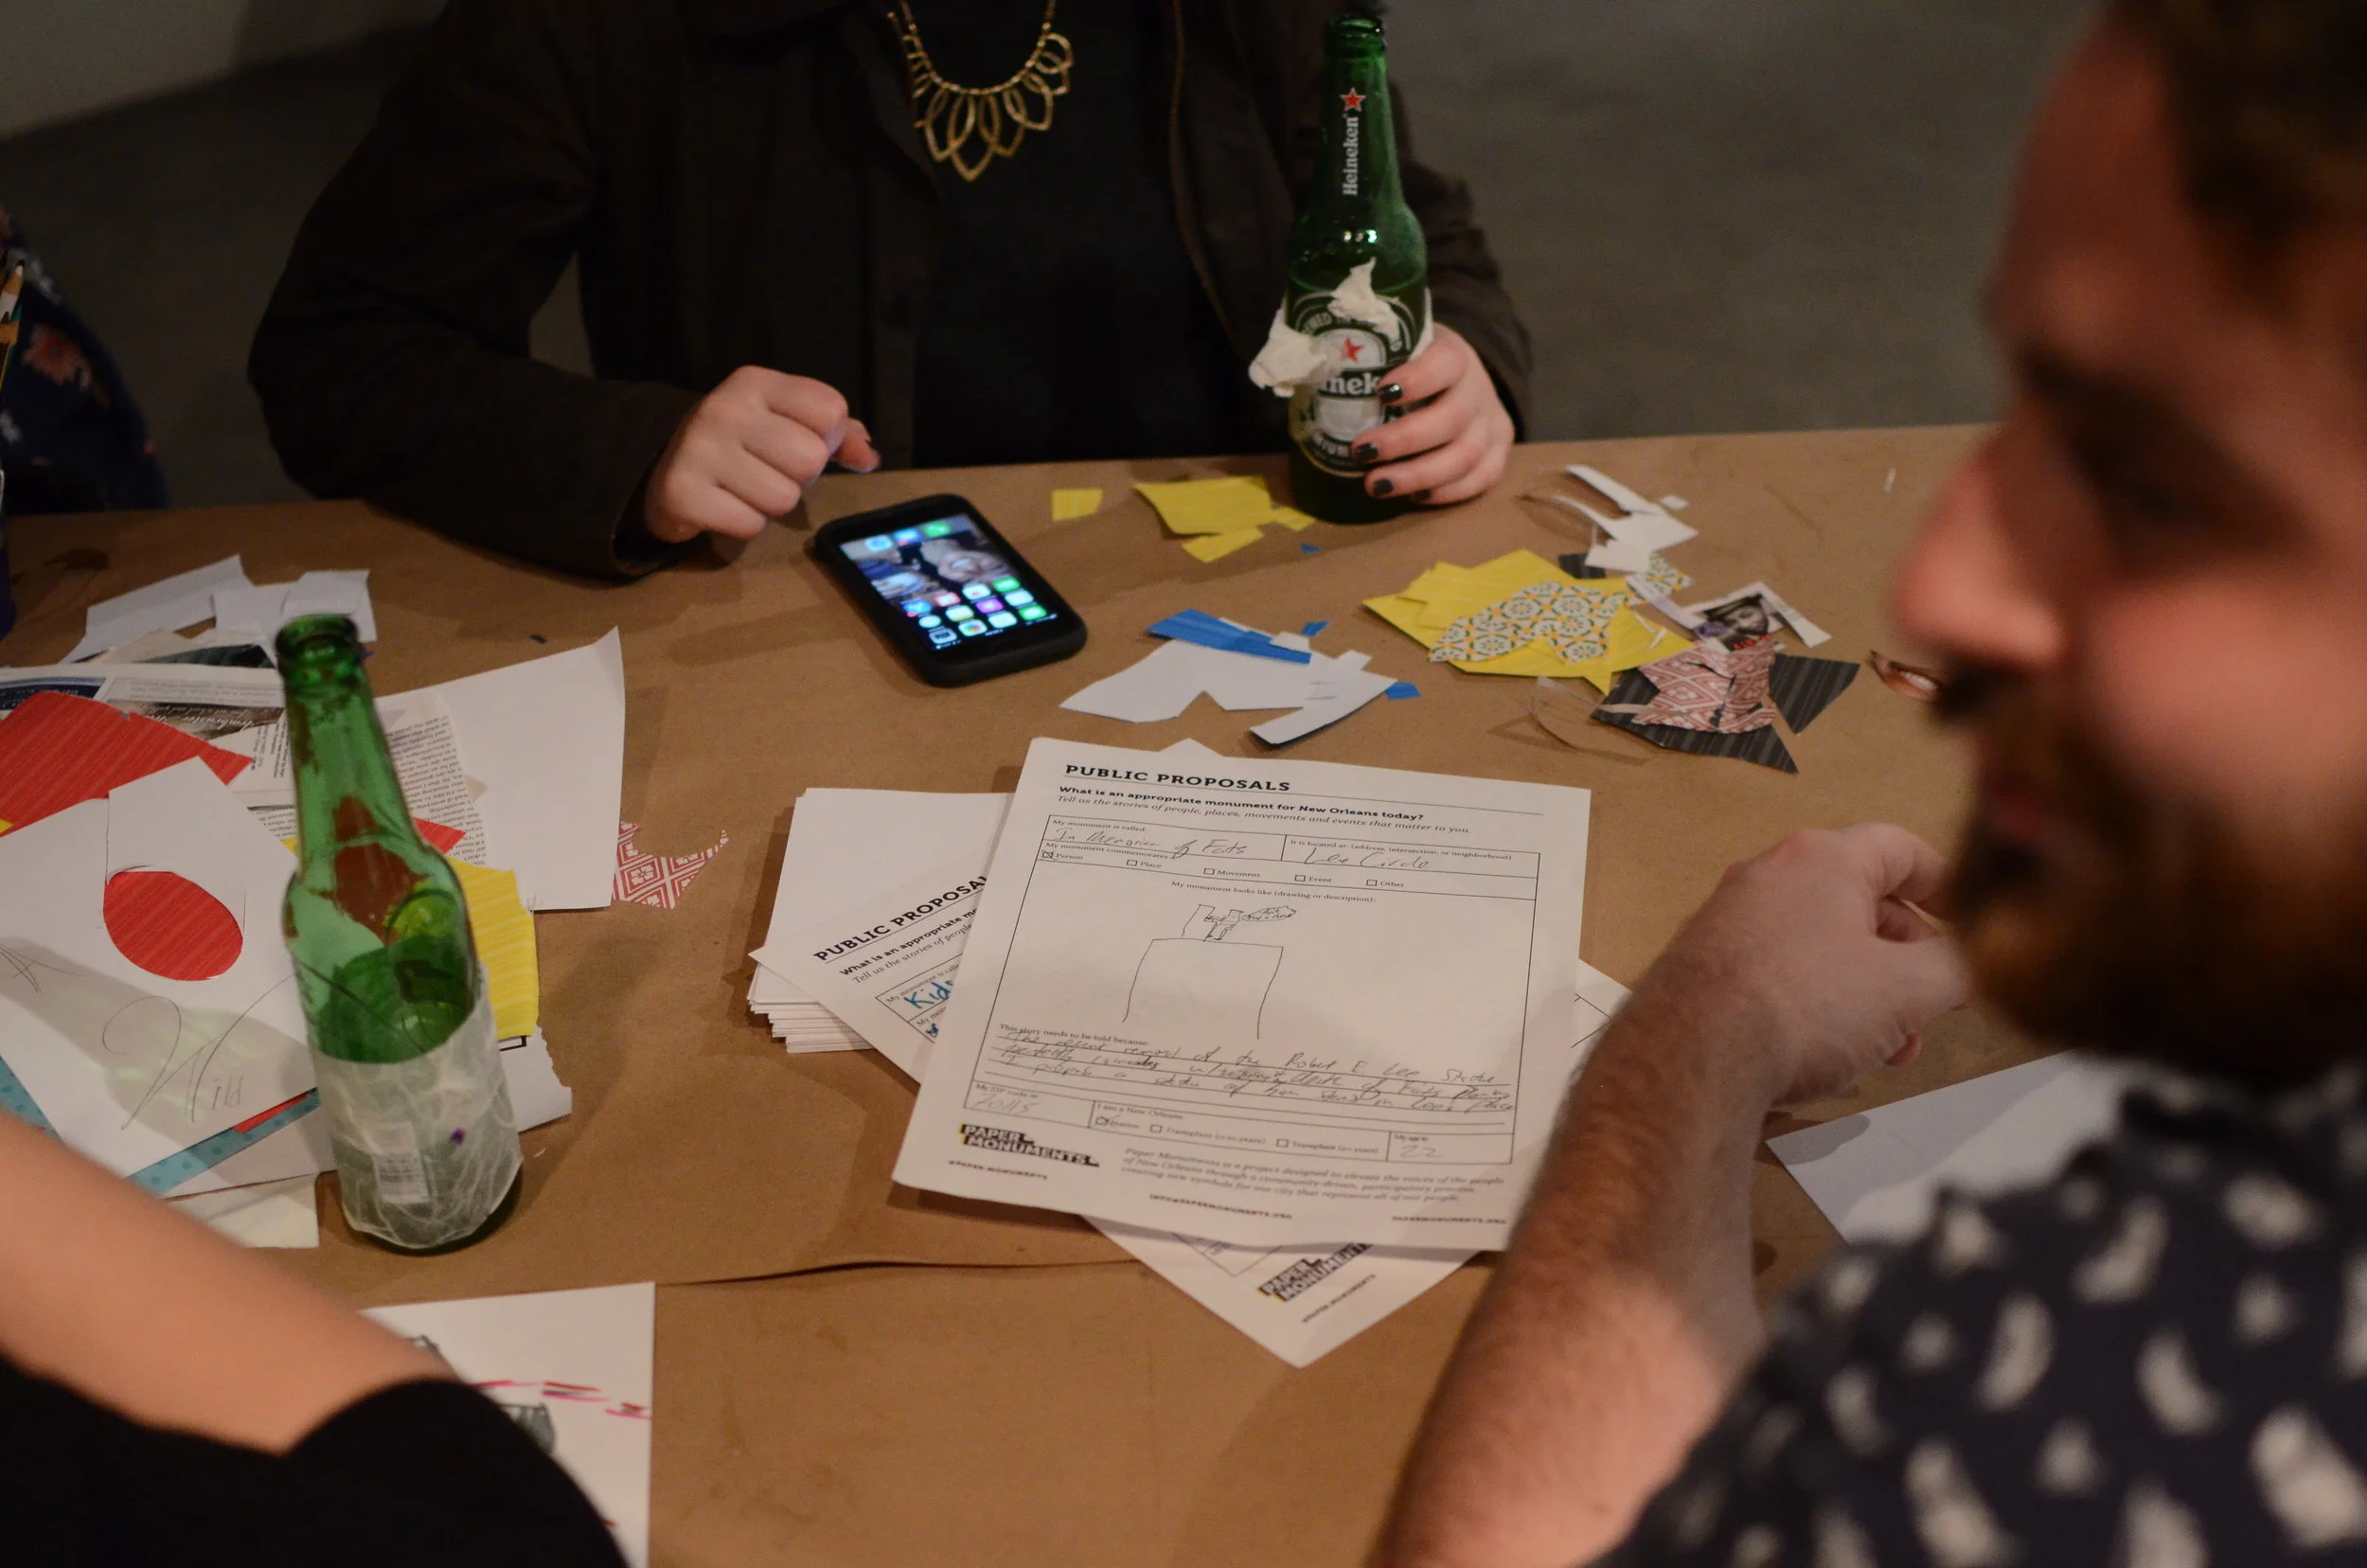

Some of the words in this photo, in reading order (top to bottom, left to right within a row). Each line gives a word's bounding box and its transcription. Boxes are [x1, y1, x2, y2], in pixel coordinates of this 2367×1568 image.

[1342, 116, 1360, 197] Heineken
[1066, 764, 1148, 781] PUBLIC
[1157, 774, 1290, 792] PROPOSALS
[1059, 786, 1093, 794] What
[1128, 792, 1201, 805] appropriate
[1205, 800, 1274, 811] monument
[1299, 805, 1326, 813] New
[1329, 808, 1378, 817] Orleans
[1382, 811, 1424, 821] today?
[1113, 799, 1148, 809] stories
[1150, 803, 1163, 812] of
[1164, 805, 1201, 815] people,
[1204, 808, 1240, 817] places,
[1244, 811, 1307, 822] movements
[1395, 822, 1432, 830] matter
[1068, 821, 1111, 829] monument
[1060, 844, 1105, 852] monument
[1308, 840, 1337, 848] located
[1304, 847, 1349, 864] Lee
[1360, 852, 1430, 869] Circle
[1217, 869, 1260, 878] Movement
[1186, 882, 1231, 893] monument
[1233, 886, 1255, 895] looks
[1274, 890, 1311, 900] (drawing
[813, 925, 891, 961] PUBLIC
[890, 876, 987, 926] PROPOSA
[840, 956, 872, 975] What
[872, 953, 882, 961] is
[884, 948, 899, 956] an
[900, 918, 962, 950] appropriate
[852, 971, 872, 984] Tell
[873, 966, 884, 974] us
[885, 958, 900, 969] the
[902, 943, 934, 961] stories
[934, 937, 944, 946] of
[900, 975, 936, 996] monument
[999, 1024, 1018, 1032] This
[1020, 1027, 1041, 1036] story
[1043, 1029, 1069, 1038] needs
[964, 1124, 1021, 1142] PAPER
[968, 1135, 1089, 1166] MONUMENTS
[1259, 1258, 1309, 1295] PAPER
